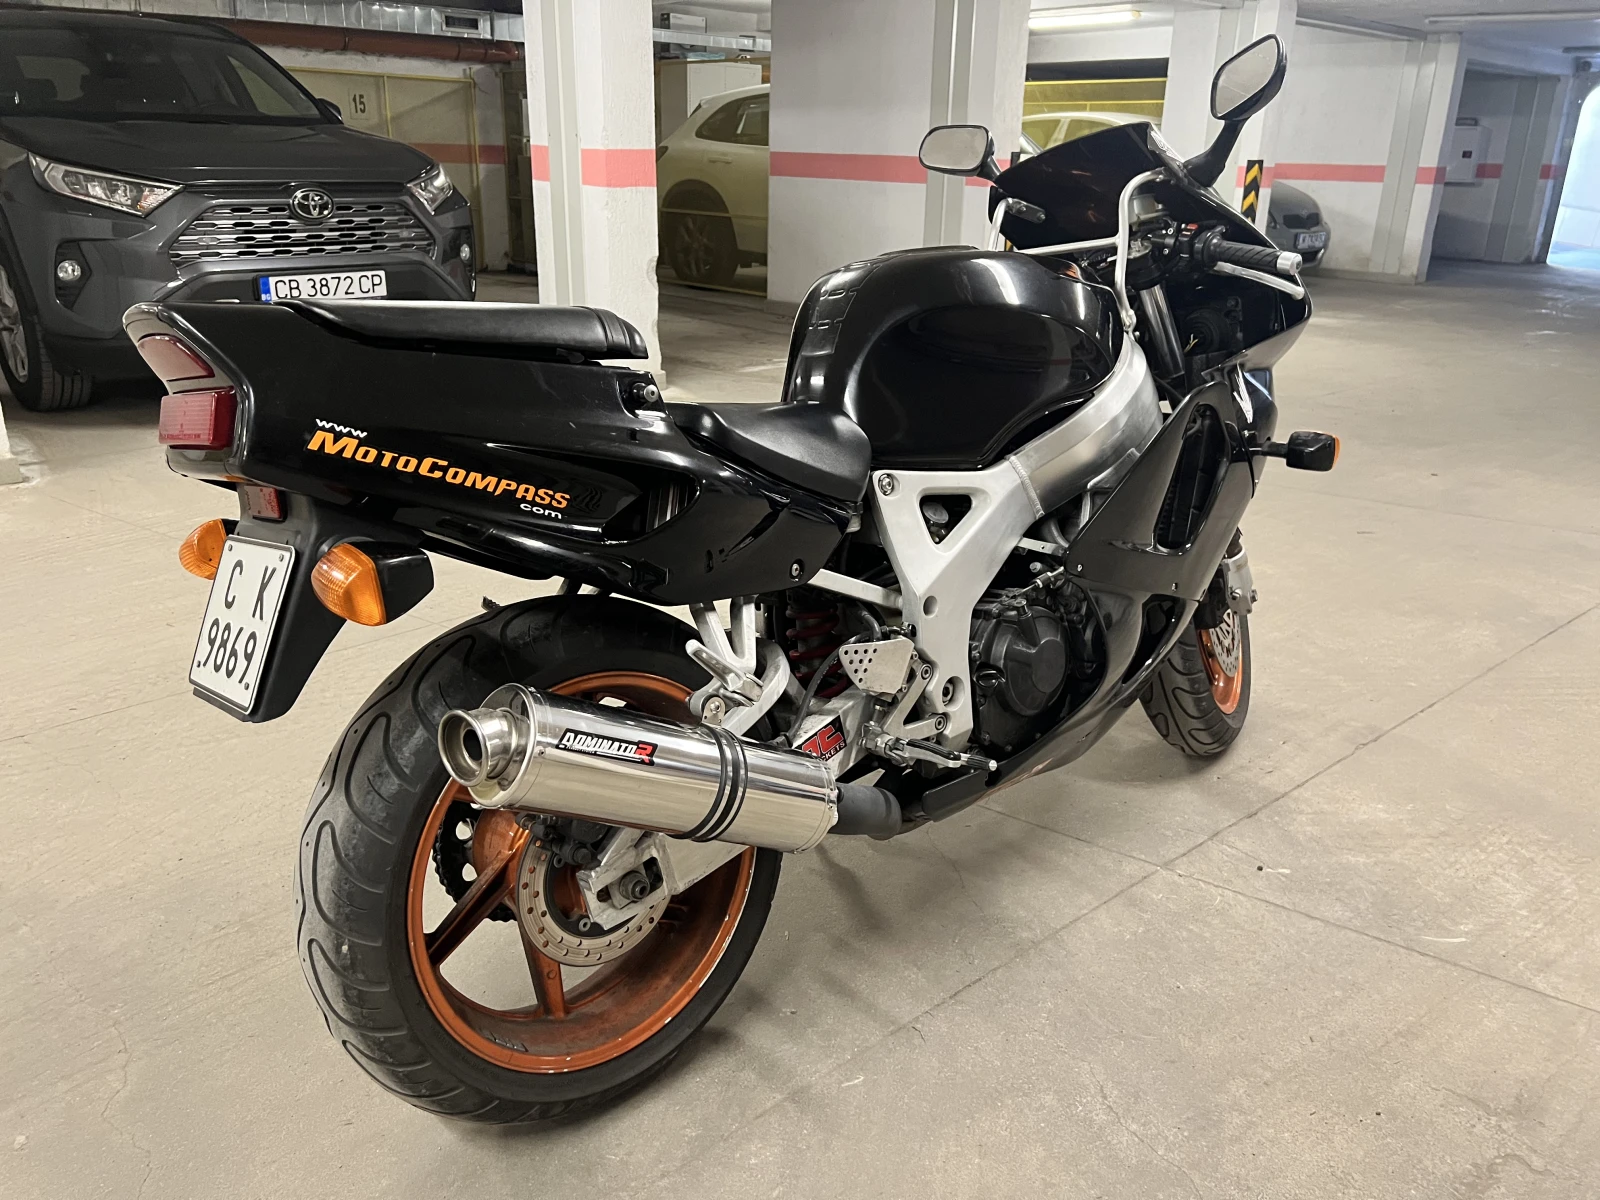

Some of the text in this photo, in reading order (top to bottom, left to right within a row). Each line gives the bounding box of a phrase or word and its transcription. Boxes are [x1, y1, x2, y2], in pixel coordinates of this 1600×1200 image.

[352, 94, 366, 114] 15
[274, 274, 383, 299] CB 3872 CP
[315, 418, 368, 438] www
[519, 503, 562, 519] com
[202, 617, 258, 684] 9869
[561, 732, 653, 763] DOMINATOR
